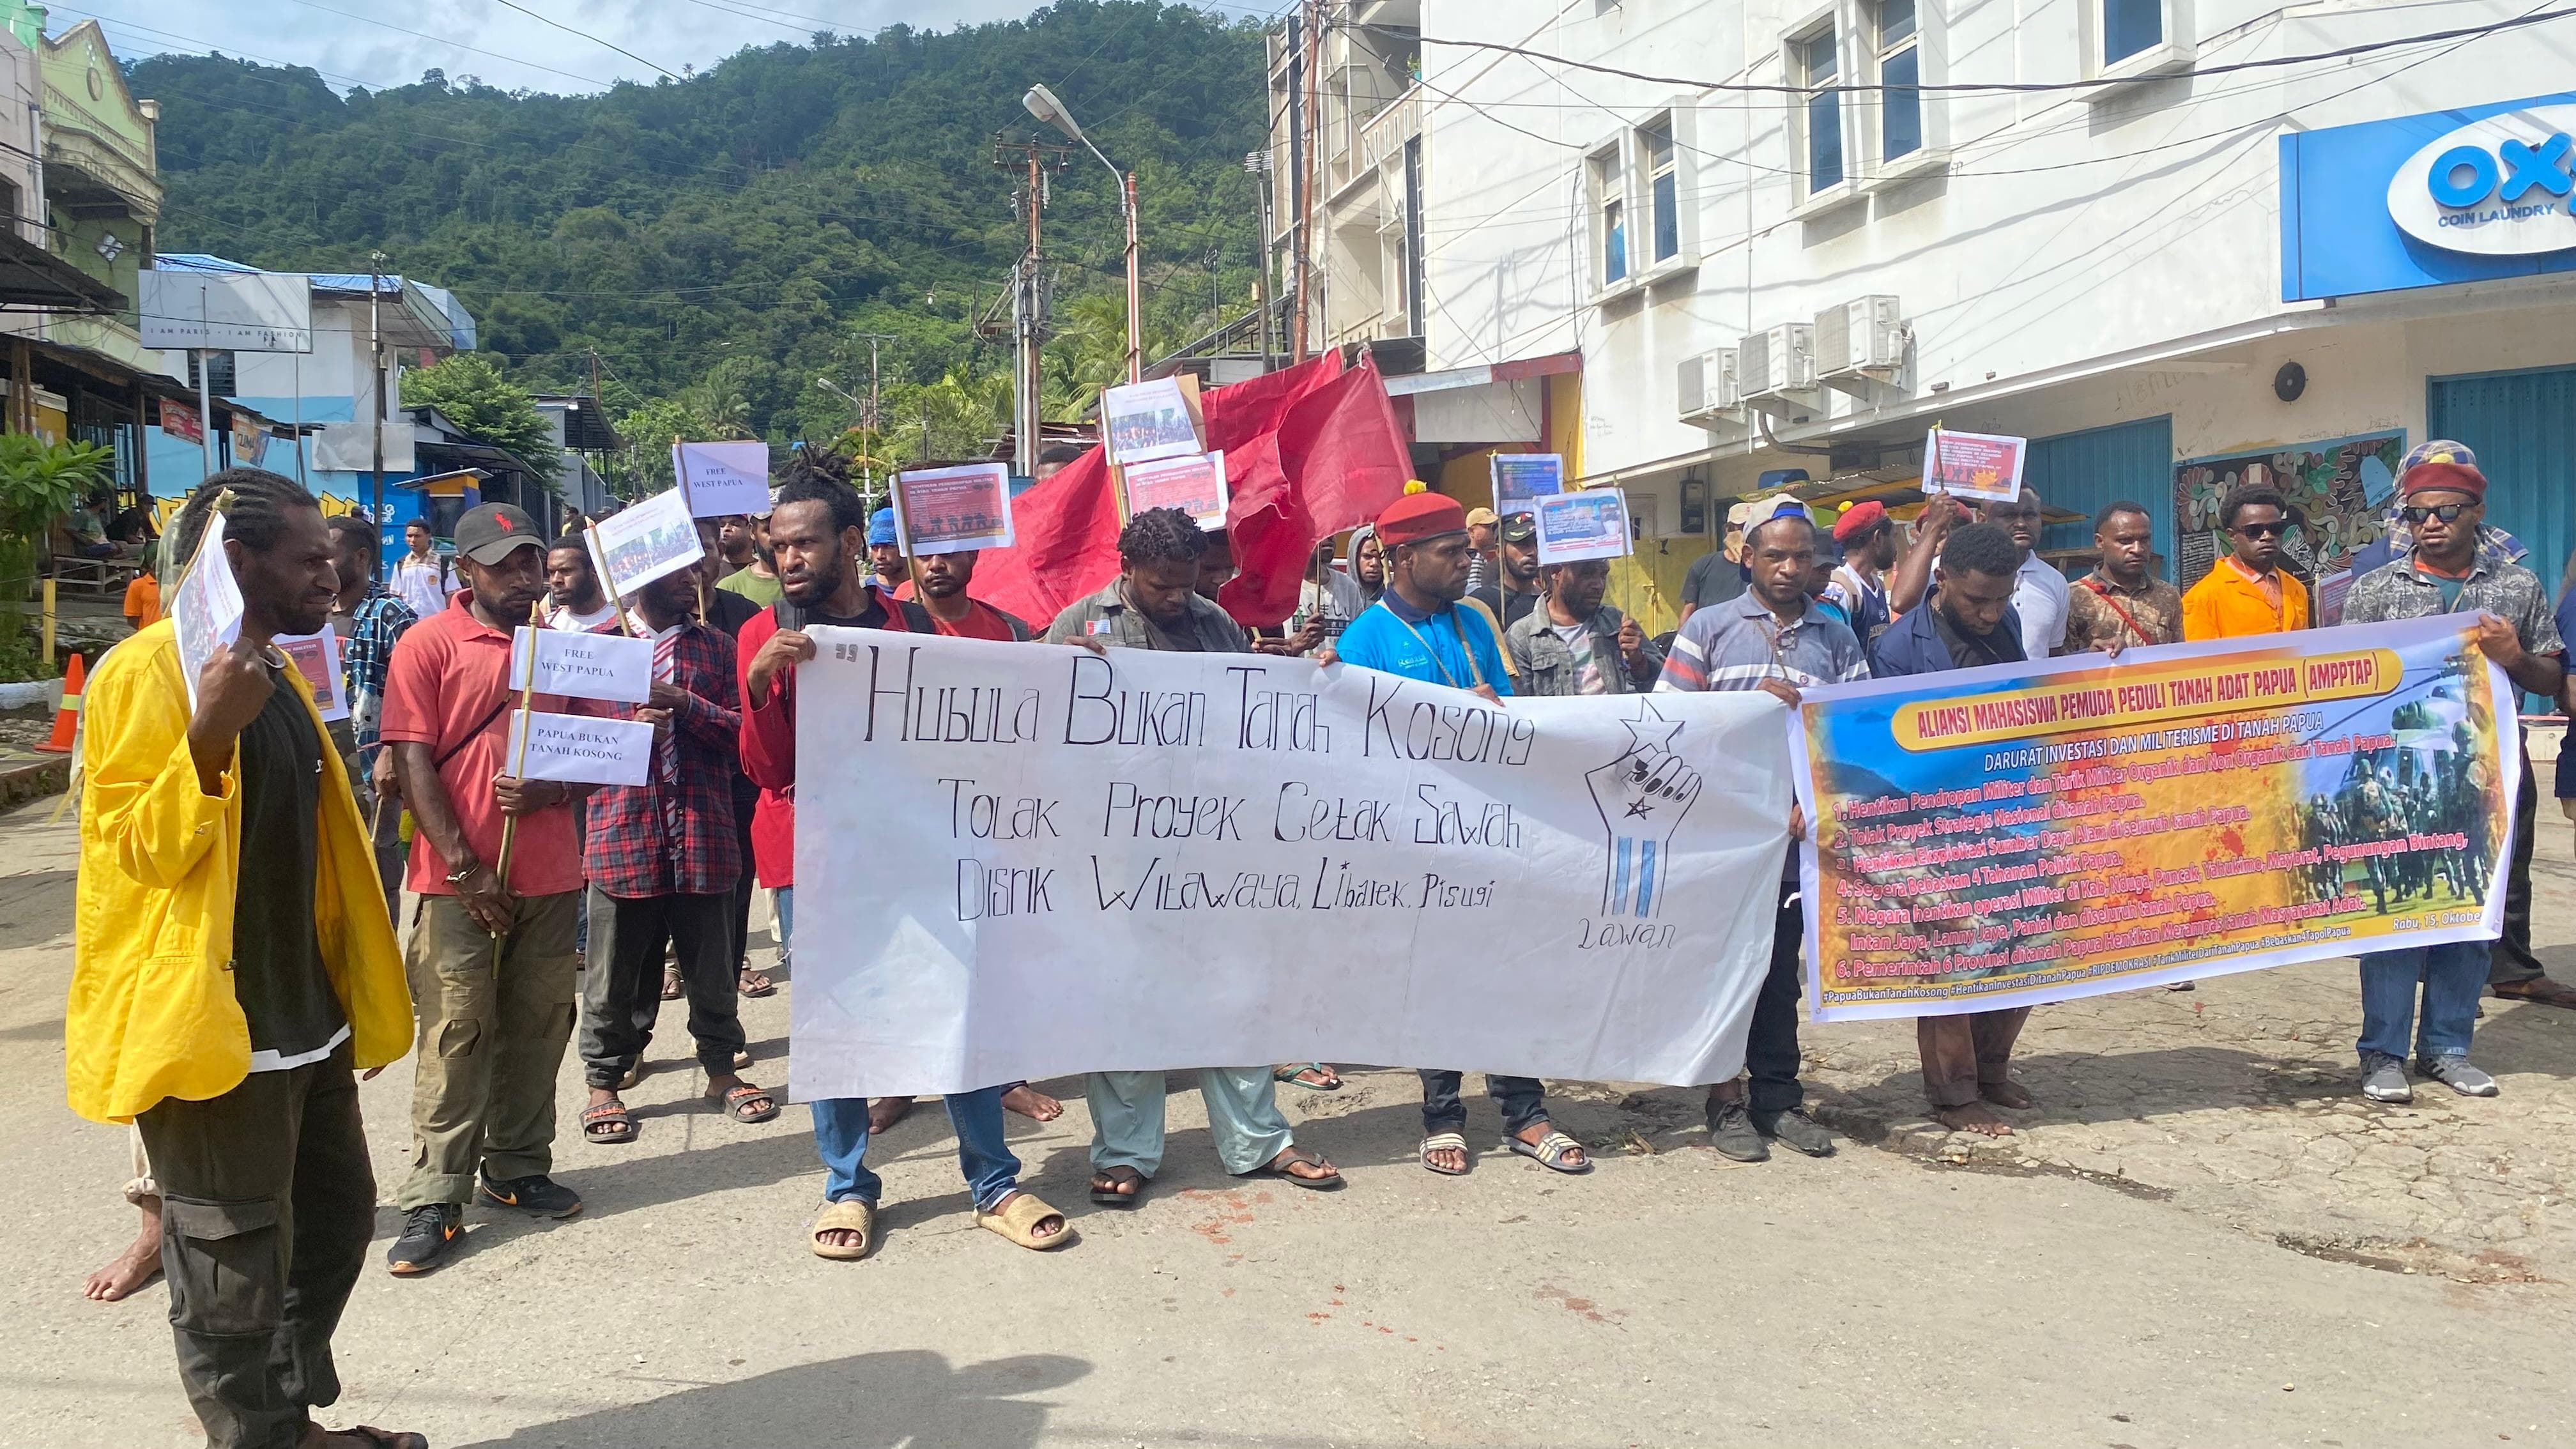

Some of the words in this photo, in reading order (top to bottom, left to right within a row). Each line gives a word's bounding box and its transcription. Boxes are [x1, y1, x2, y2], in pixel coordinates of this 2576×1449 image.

[2428, 132, 2576, 215] OX
[2439, 212, 2475, 227] COIN
[2480, 203, 2555, 222] LAUNDRY
[257, 330, 302, 339] FASHION
[694, 480, 716, 489] WEST
[718, 479, 743, 487] PAPUA
[706, 467, 726, 475] FREE
[541, 661, 574, 673] WEST
[577, 666, 614, 677] PAPUA
[565, 648, 595, 659] FREE
[1919, 707, 1971, 739] ALIANSI
[1976, 697, 2057, 731] MAHASISWA
[2061, 691, 2115, 722] PEMUDA
[2119, 684, 2165, 714] PEDULI
[2168, 677, 2212, 704] TANAH
[2217, 673, 2250, 702] ADAT
[2253, 666, 2297, 697] PAPUA
[2302, 651, 2380, 699] (AMPPTAP)
[530, 743, 570, 756] TANAH
[574, 747, 622, 762] KOSONG
[537, 728, 575, 741] PAPUA
[578, 733, 619, 746] BUKAN
[1984, 747, 2044, 772] DARURAT
[2045, 739, 2107, 766] INVESTASI
[2110, 735, 2138, 756] DAN
[2140, 723, 2219, 752] MILITERISME
[2221, 723, 2235, 742] DI
[2237, 717, 2280, 740] TANAH
[2281, 711, 2324, 734] PAPUA
[1832, 802, 1848, 822] 1.
[1848, 795, 1909, 820] Hentikan
[1910, 786, 1982, 809] Pendropan
[1982, 778, 2025, 801] Militer
[2027, 775, 2052, 795] dan
[2052, 769, 2086, 791] Tarik
[2086, 765, 2128, 788] Militer
[2128, 754, 2181, 785] Organik
[2182, 755, 2206, 774] dan
[2206, 751, 2235, 771] Non
[2235, 743, 2287, 770] Organik
[2287, 740, 2312, 761] dari
[2313, 736, 2352, 757] Tanah
[2352, 732, 2396, 755] Papua.
[1834, 830, 1848, 849] 2.
[1850, 824, 1885, 847] Tolak
[1886, 818, 1933, 843] Proyek
[1935, 812, 1993, 836] Strategis
[1994, 801, 2050, 827] Nasional
[2052, 793, 2101, 819] ditanah
[2101, 793, 2147, 815] Papua.
[1836, 858, 1851, 871] 3.
[1853, 852, 1917, 874] Hentikan
[1916, 841, 1988, 867] Eksploitasi
[1988, 833, 2039, 855] Sumber
[2041, 829, 2074, 850] Daya
[2076, 824, 2108, 844] Alam
[2109, 820, 2123, 839] di
[2124, 813, 2170, 837] seluruh
[2172, 808, 2208, 831] tanah
[2209, 804, 2253, 827] Papua.
[1836, 879, 1852, 898] 4.
[1853, 879, 1908, 901] Segera
[1908, 871, 1971, 896] Bebaskan
[1972, 868, 1981, 885] 4
[1981, 863, 2037, 885] Tahanan
[2037, 854, 2082, 877] Politik
[2081, 851, 2124, 871] Papua.
[1836, 907, 1852, 924] 5.
[1854, 906, 1910, 928] Negara
[1912, 900, 1974, 923] hentikan
[1974, 889, 2020, 918] operasi
[2022, 884, 2066, 907] Militer
[2066, 884, 2080, 901] di
[2110, 873, 2154, 895] Nduga,
[2154, 862, 2203, 886] Puncak,
[2202, 855, 2266, 880] Yahukimo,
[2267, 847, 2322, 871] Maybrat,
[2323, 836, 2407, 864] Pegunungan
[2409, 831, 2469, 852] Bintang,
[1836, 960, 1851, 979] 6.
[1853, 954, 1940, 977] Pemerintah
[1942, 956, 1952, 974] 6
[1954, 948, 2009, 972] Provinsi
[2011, 939, 2061, 964] ditanah
[2063, 936, 2104, 961] Papua
[2104, 925, 2161, 950] Hentikan
[2161, 917, 2223, 942] Merampas
[2224, 908, 2258, 931] tanah
[2259, 898, 2331, 925] Masyarakat
[2332, 894, 2368, 913] Adat.
[1850, 933, 1891, 952] Intan
[1893, 933, 1931, 954] Jaya,
[1933, 928, 1976, 948] Lanny
[1977, 923, 2011, 943] Jaya,
[2012, 912, 2052, 939] Paniai
[2053, 910, 2077, 930] dan
[2079, 901, 2137, 927] diseluruh
[2138, 895, 2174, 917] tanah
[2174, 890, 2217, 914] Papua.
[2393, 916, 2422, 931] Rabu,
[1823, 986, 1949, 1004] #PapuaBukanTanahKosong
[2087, 956, 2151, 977] #RIPDEMOKRASI
